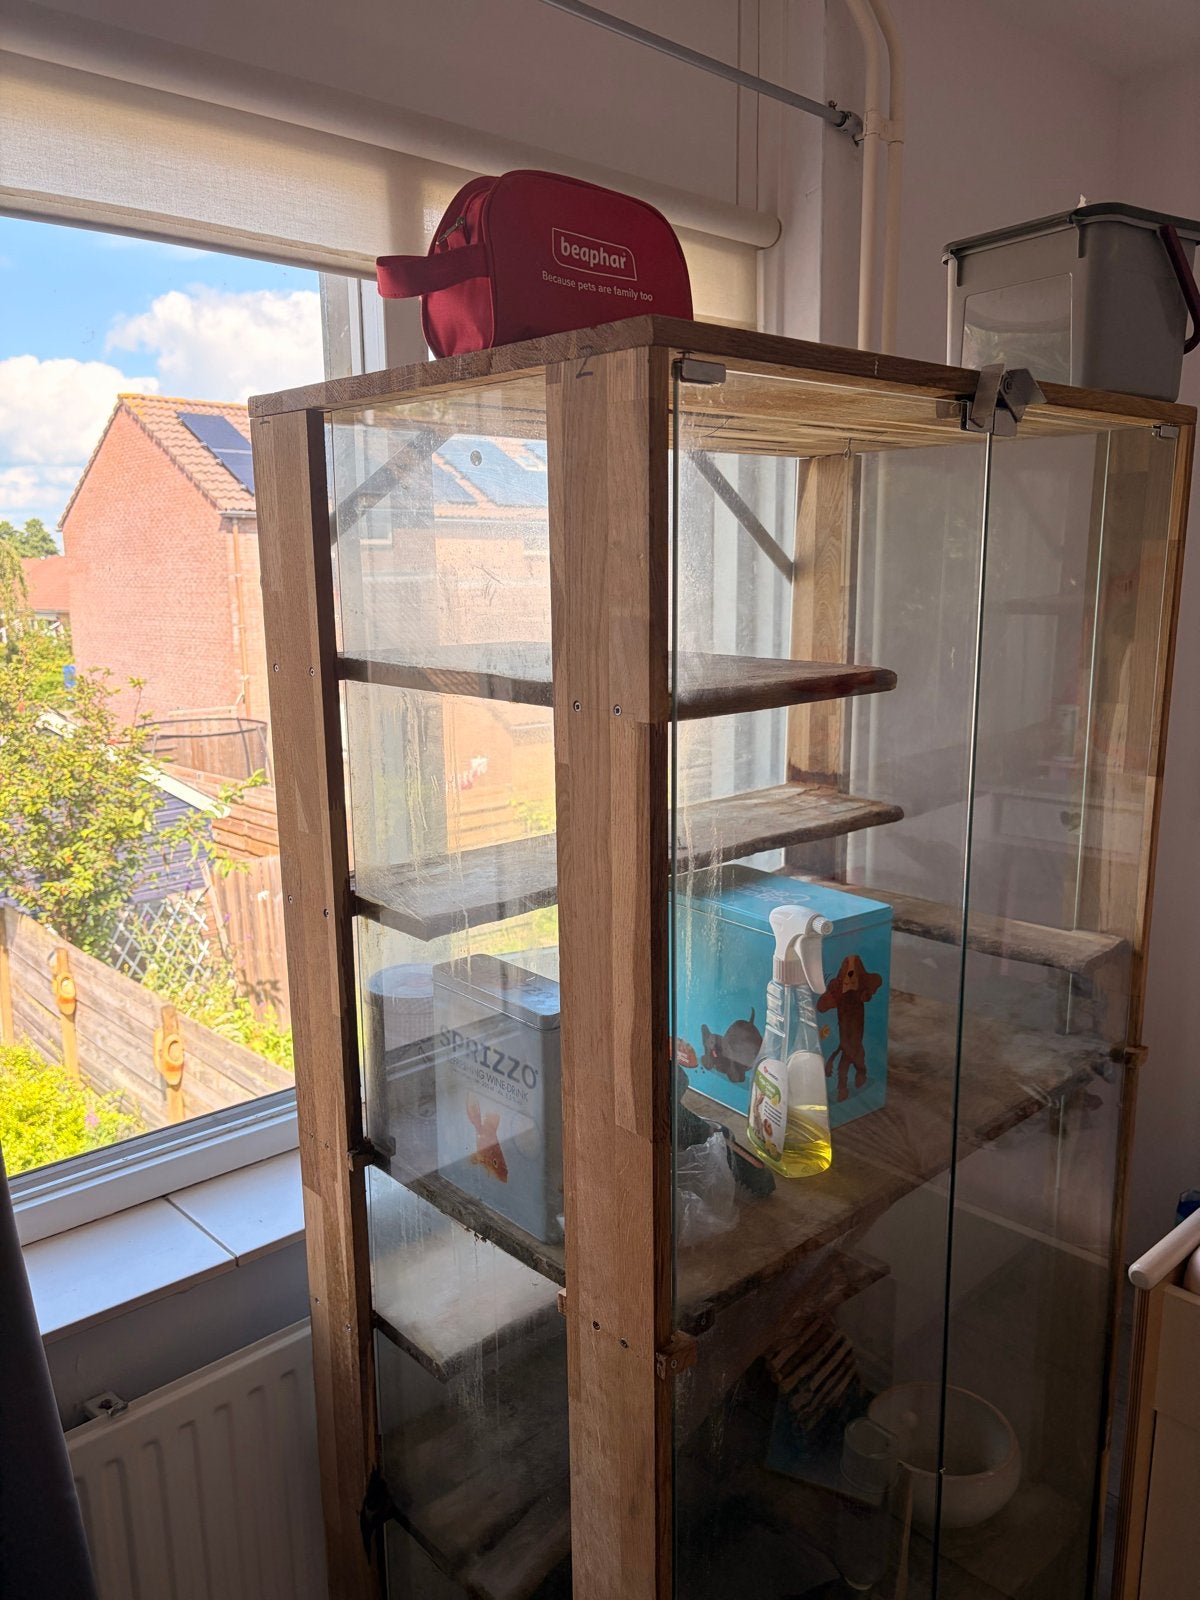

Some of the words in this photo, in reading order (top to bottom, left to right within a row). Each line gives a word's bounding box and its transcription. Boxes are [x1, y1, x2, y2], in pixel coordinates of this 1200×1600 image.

[560, 236, 626, 269] beaphar
[542, 270, 576, 288] Because
[578, 281, 596, 292] pets
[598, 285, 612, 295] are
[614, 286, 639, 301] family
[640, 291, 653, 302] too
[440, 1025, 537, 1090] SPRIZZO
